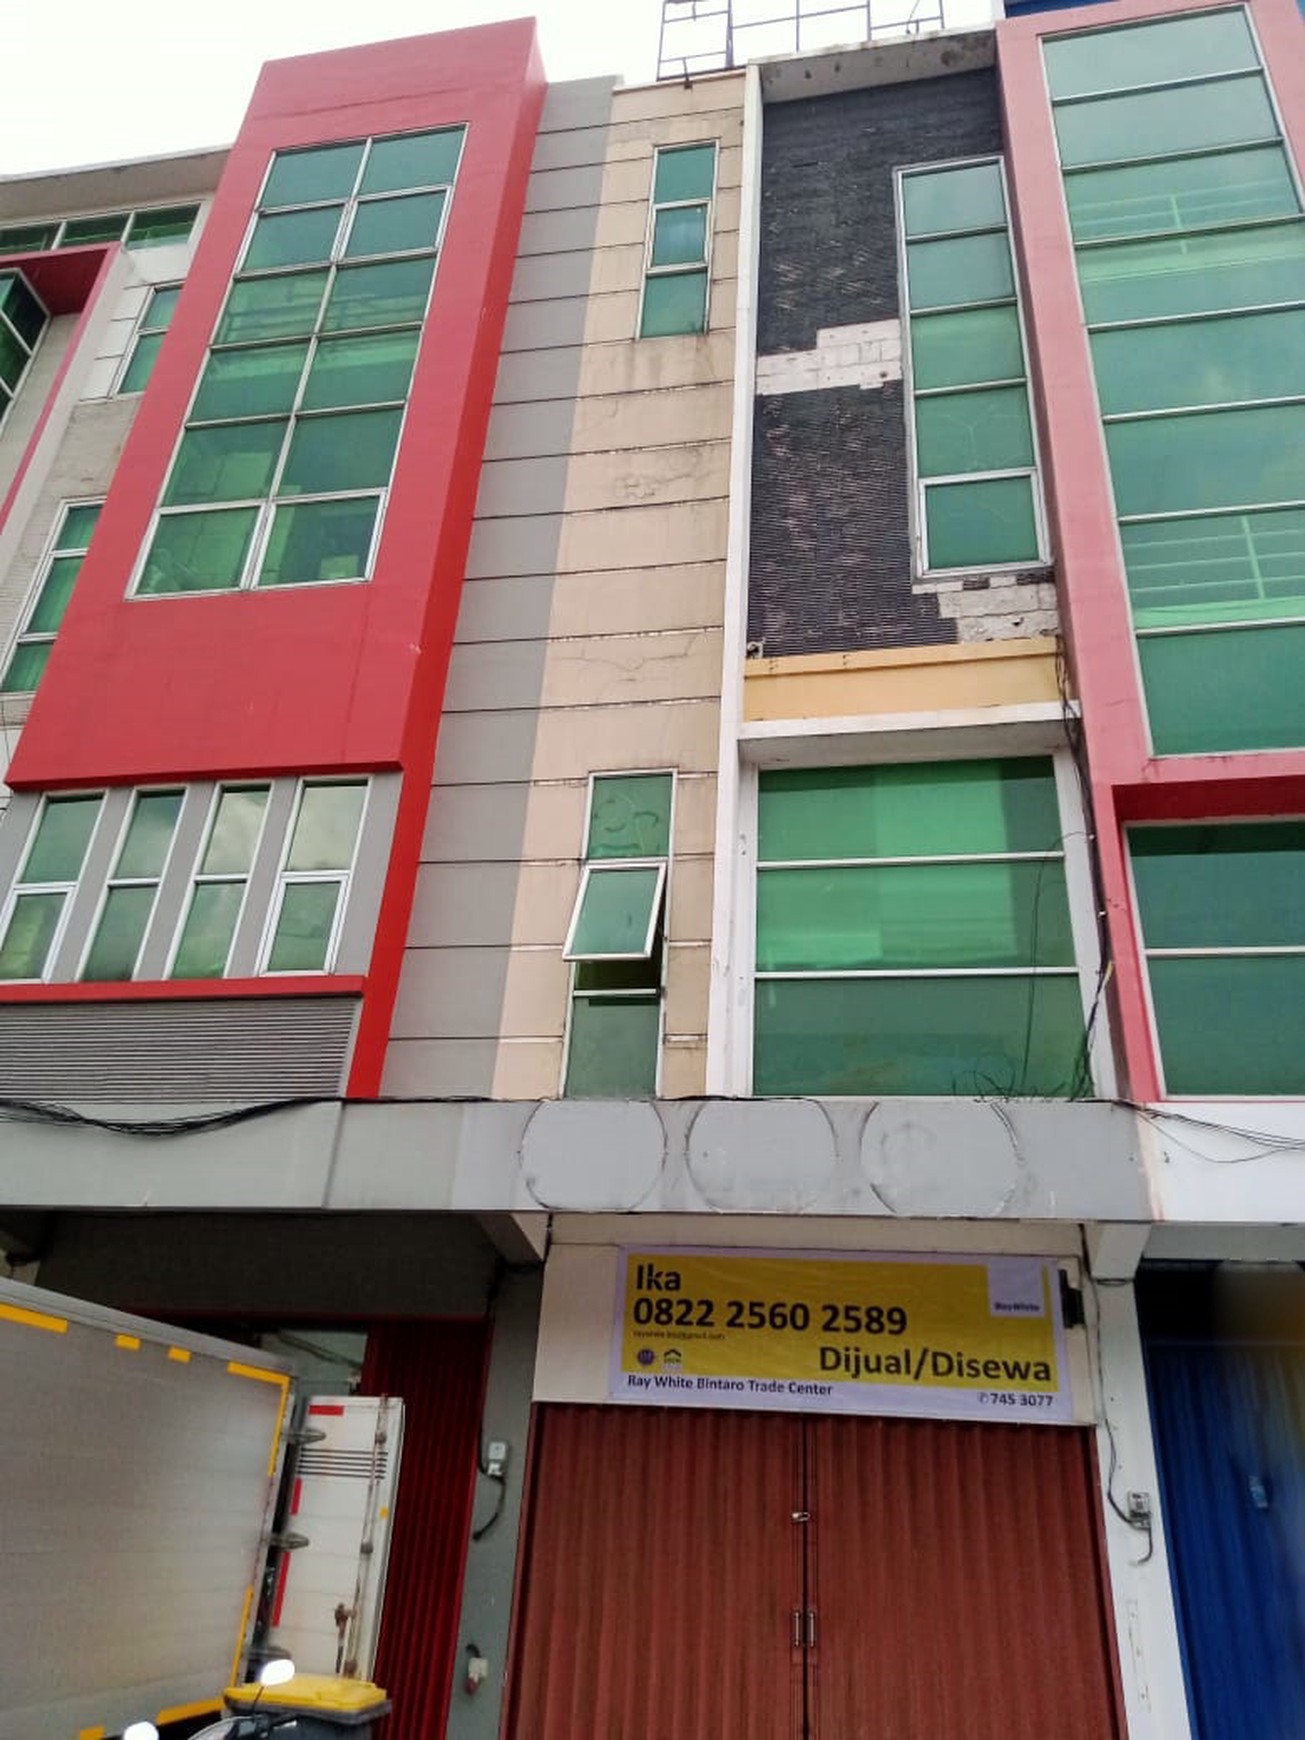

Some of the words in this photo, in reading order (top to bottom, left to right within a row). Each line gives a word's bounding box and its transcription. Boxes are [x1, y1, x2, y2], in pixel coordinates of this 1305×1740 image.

[636, 1264, 681, 1291] Ika
[633, 1298, 715, 1328] 0822
[726, 1301, 810, 1331] 2560
[821, 1304, 908, 1336] 2589
[820, 1346, 1052, 1381] Dijual/Disewa
[628, 1375, 651, 1388] Ray
[655, 1376, 693, 1390] White
[697, 1378, 744, 1392] Bintaro
[749, 1380, 784, 1393] Trade
[788, 1382, 834, 1396] Center
[990, 1393, 1016, 1405] 745
[1020, 1394, 1054, 1406] 3077
